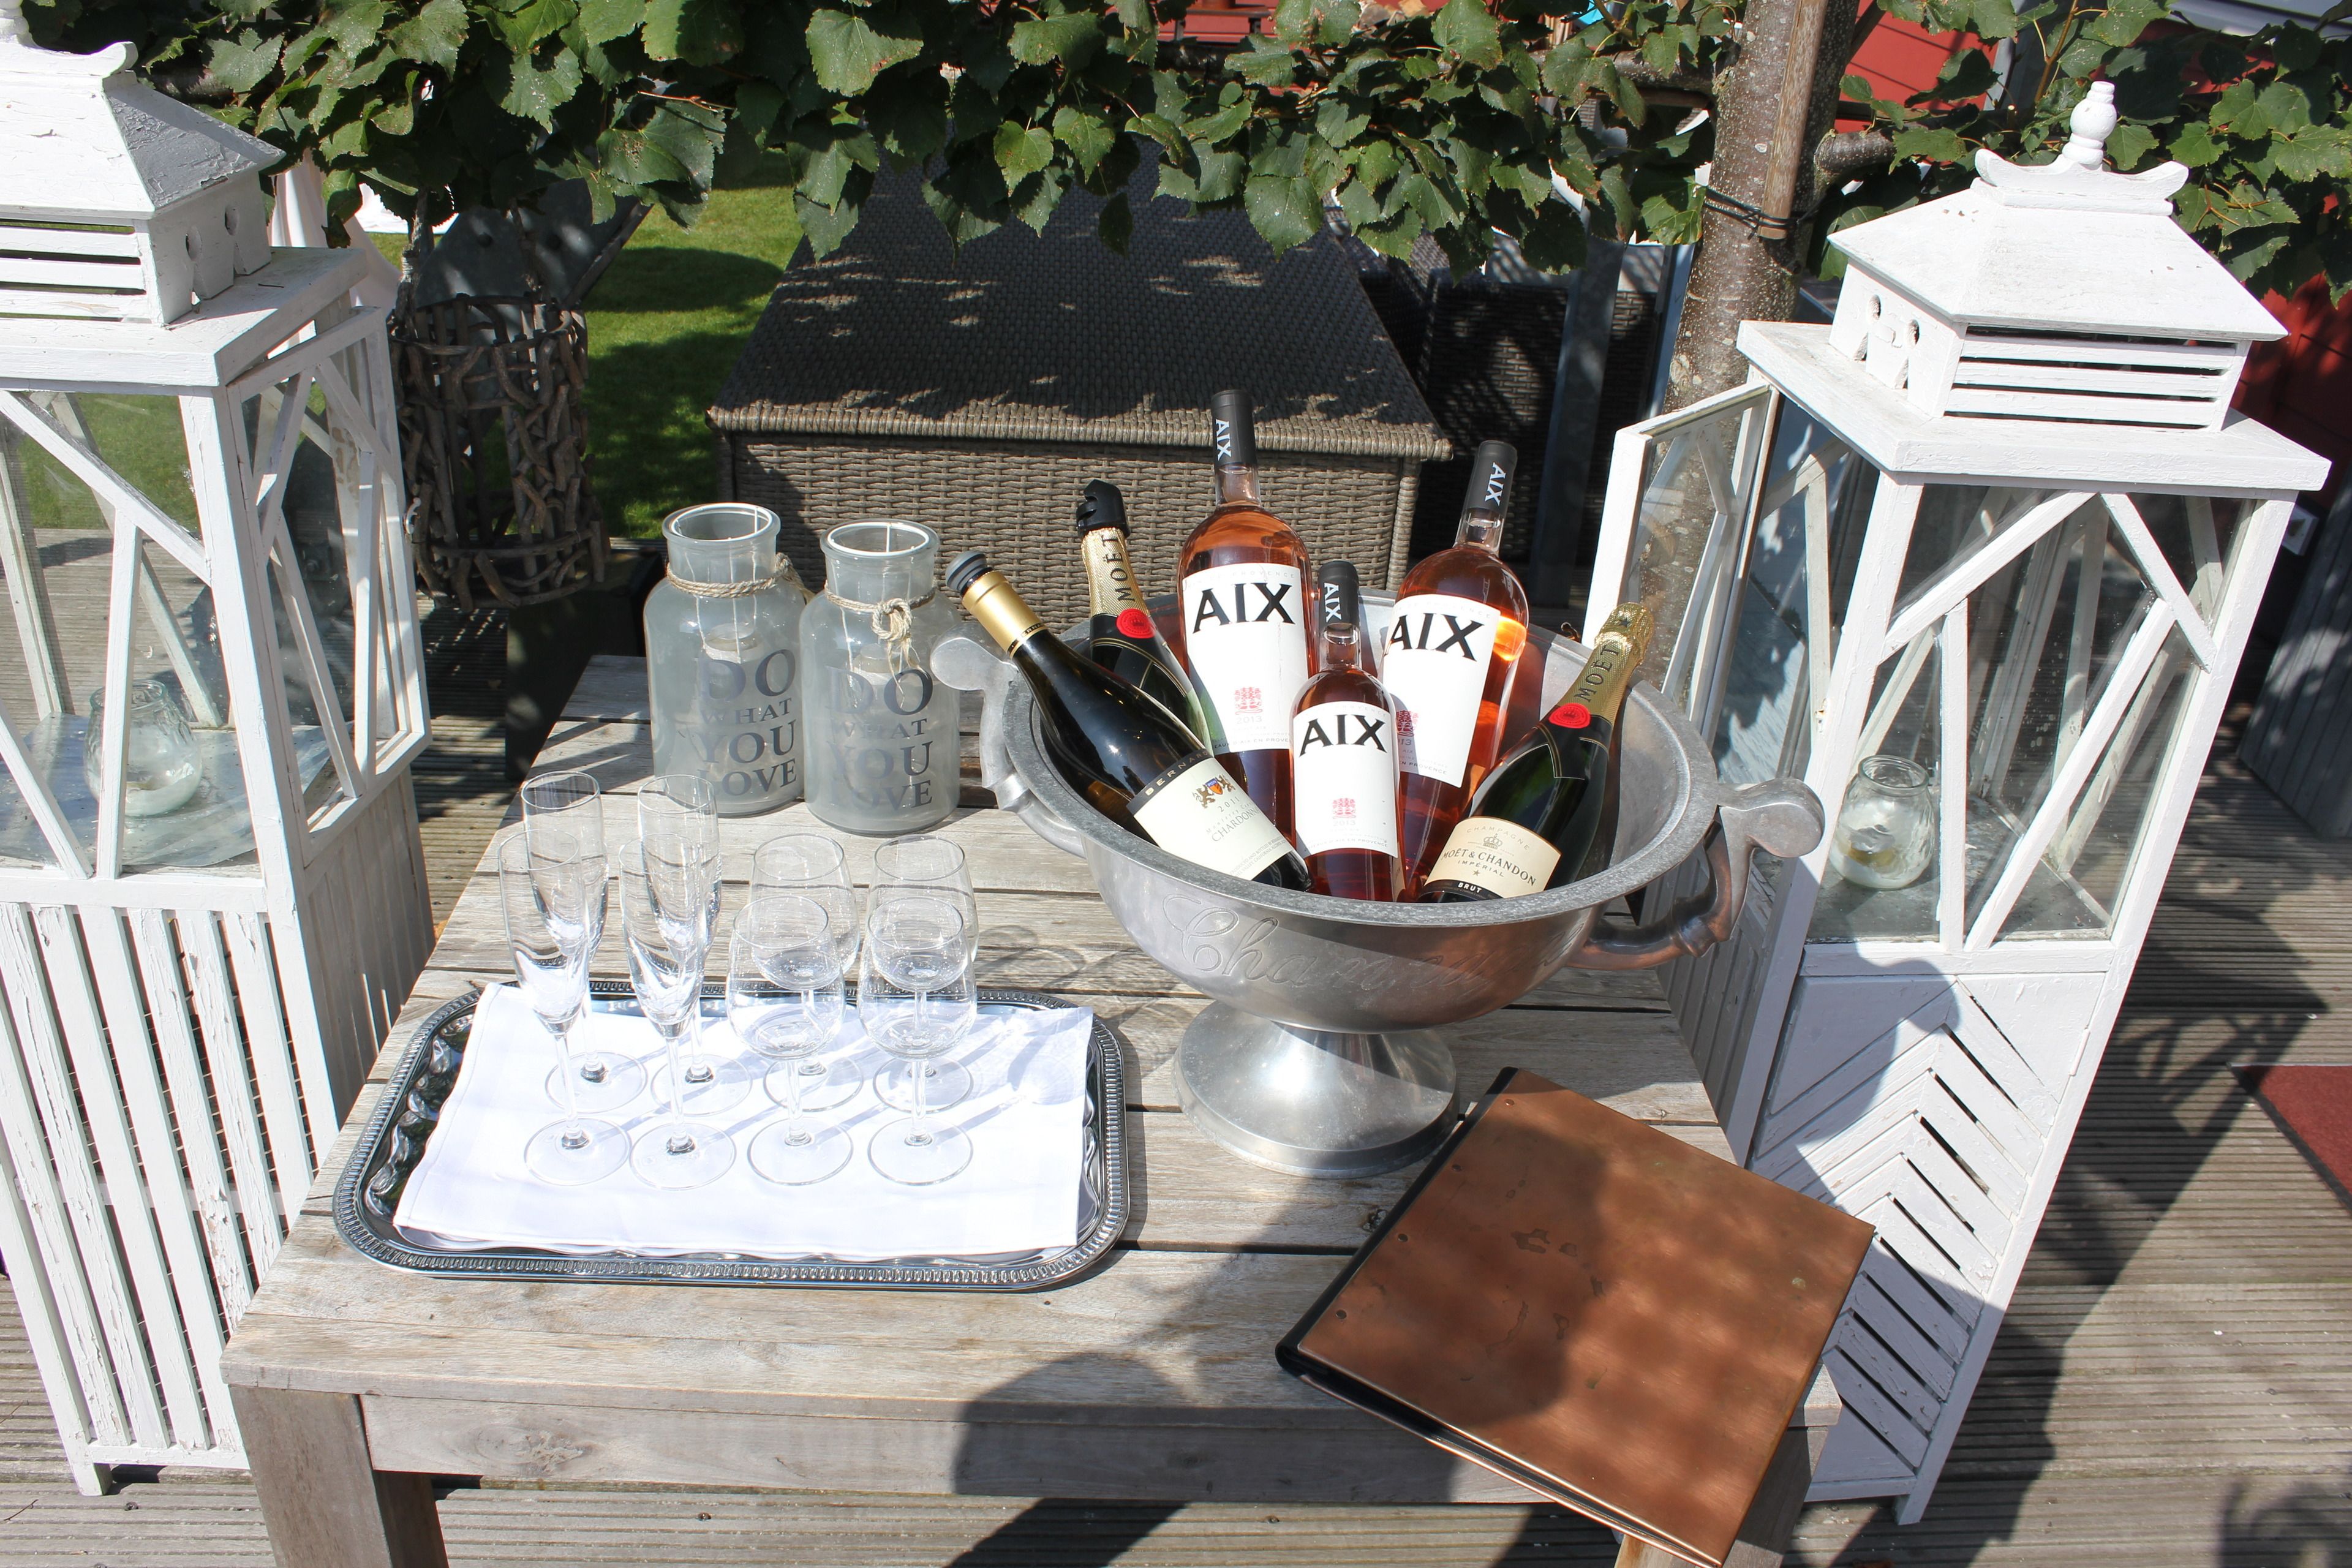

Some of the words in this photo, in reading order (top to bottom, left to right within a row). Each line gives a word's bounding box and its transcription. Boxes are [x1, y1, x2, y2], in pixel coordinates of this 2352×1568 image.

[1216, 419, 1232, 461] AIX
[1485, 462, 1506, 506] AIX
[1101, 534, 1136, 602] MOËT
[1193, 582, 1295, 633] AIX
[1324, 582, 1342, 622] AIX
[1383, 612, 1485, 662] AIX
[694, 649, 796, 701] DO
[824, 666, 933, 715] DO
[1574, 645, 1619, 703] MOËT
[700, 698, 791, 725] WHAT
[1236, 715, 1262, 724] 2013
[698, 720, 796, 763] YOU
[1299, 714, 1387, 757] AIX
[696, 758, 796, 796] LOVE
[826, 741, 933, 780] YOU
[1218, 796, 1240, 812] 2011
[1467, 826, 1529, 850] CHAMPAGNE
[1458, 860, 1504, 878] IMPÉRIAL
[1458, 882, 1482, 893] BRUT
[1478, 851, 1536, 886] CHANDON
